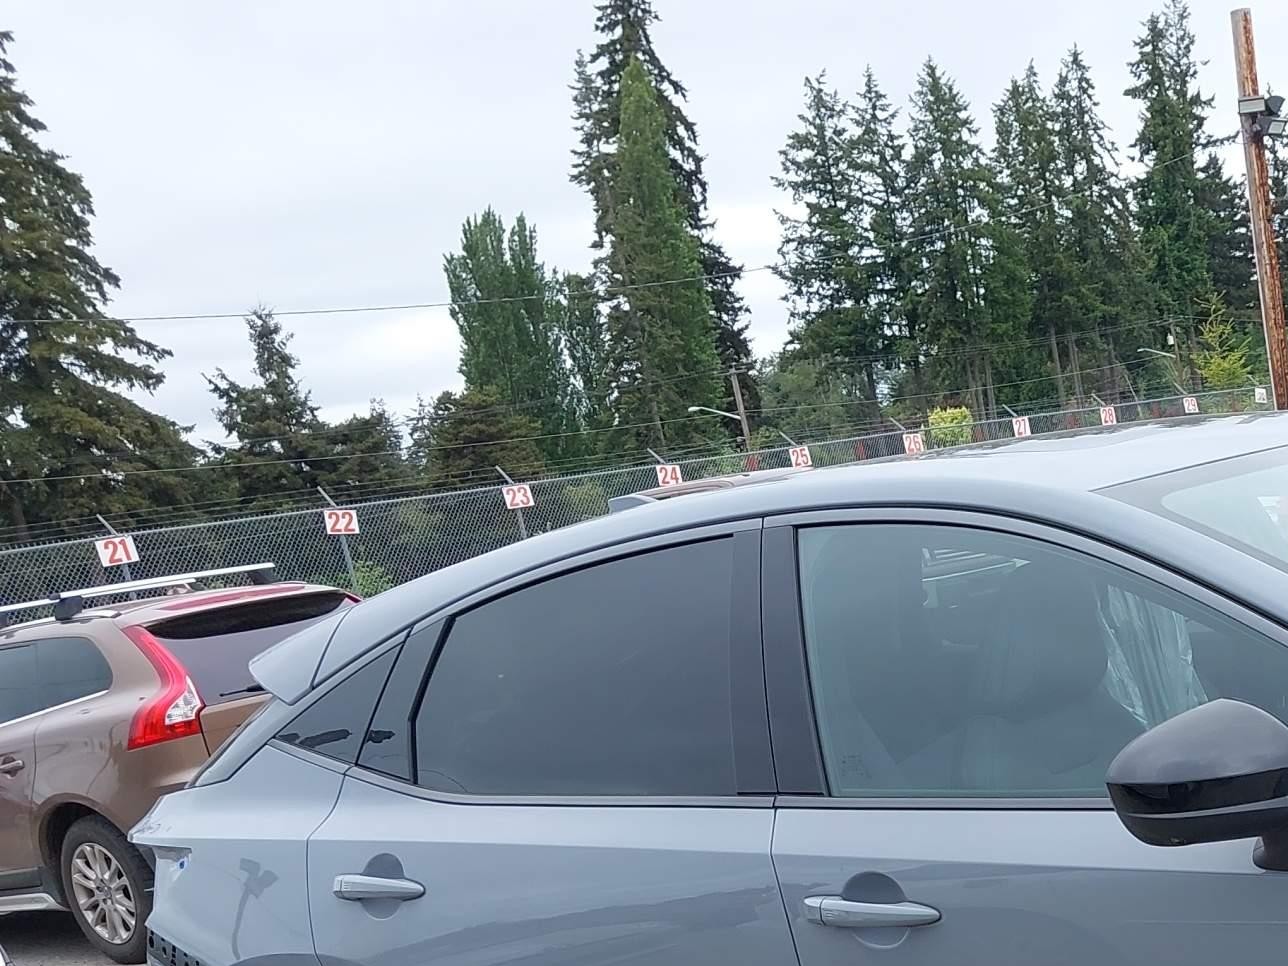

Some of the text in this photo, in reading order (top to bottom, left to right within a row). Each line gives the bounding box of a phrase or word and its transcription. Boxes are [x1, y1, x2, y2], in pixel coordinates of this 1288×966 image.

[1184, 398, 1197, 412] 29
[1102, 408, 1114, 424] 28
[1015, 418, 1027, 436] 27
[905, 435, 920, 452] 26
[792, 447, 809, 467] 25
[659, 466, 679, 485] 24
[506, 486, 530, 507] 23
[328, 511, 356, 533] 22
[103, 538, 132, 565] 21
